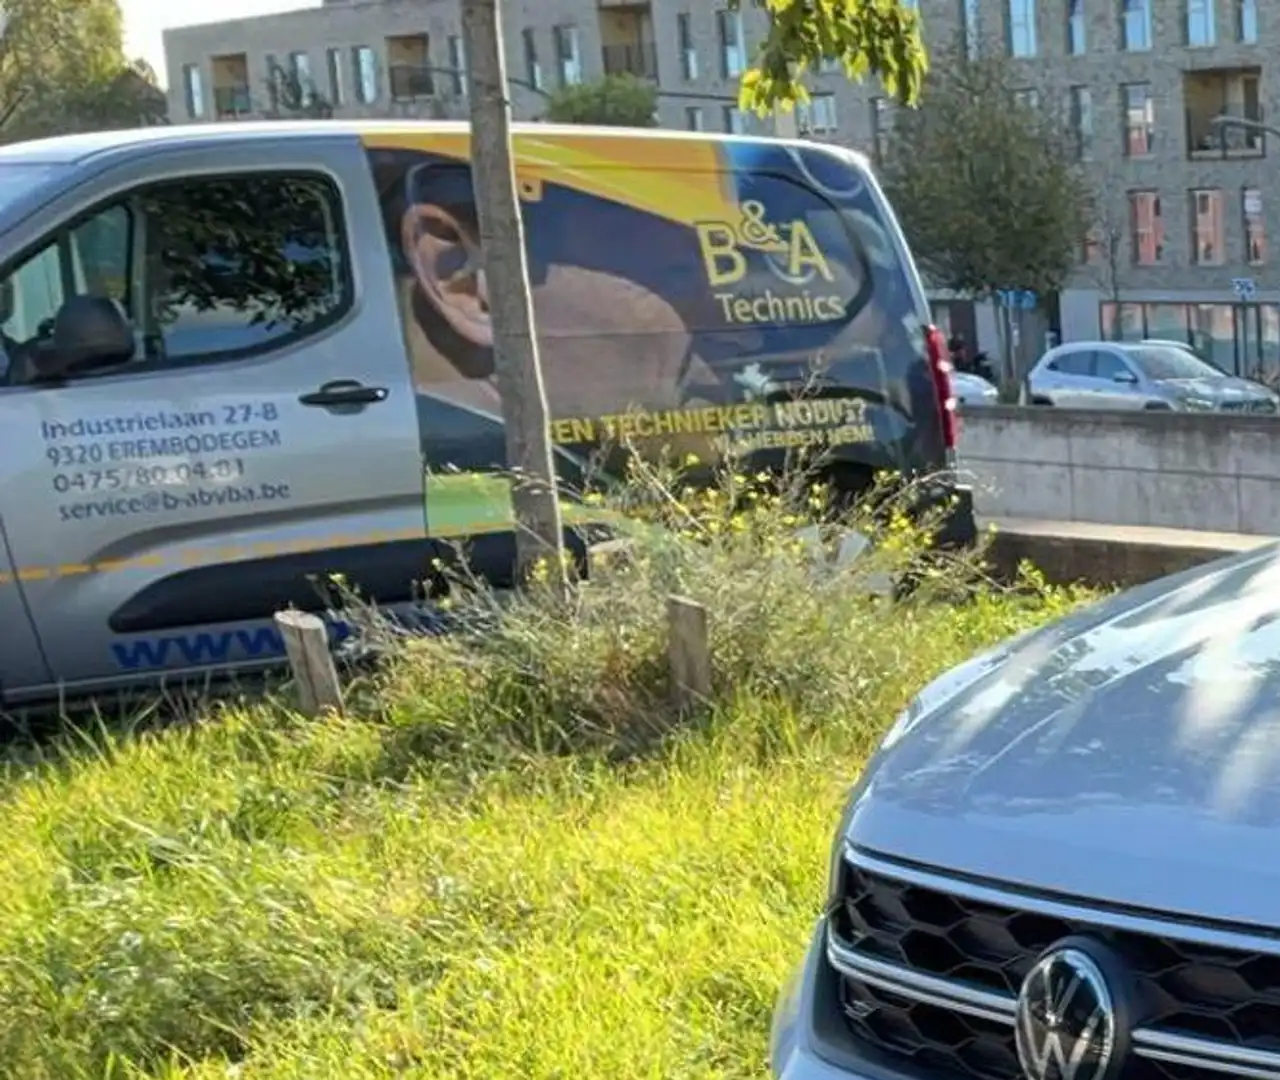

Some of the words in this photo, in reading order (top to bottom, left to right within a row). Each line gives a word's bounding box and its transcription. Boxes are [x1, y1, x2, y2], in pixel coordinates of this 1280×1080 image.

[694, 200, 834, 287] B&A
[714, 289, 847, 324] Technics
[41, 409, 216, 439] Industrielaan
[549, 417, 594, 444] EN
[46, 442, 102, 468] 9320
[107, 428, 282, 461] EREMBODEGEM
